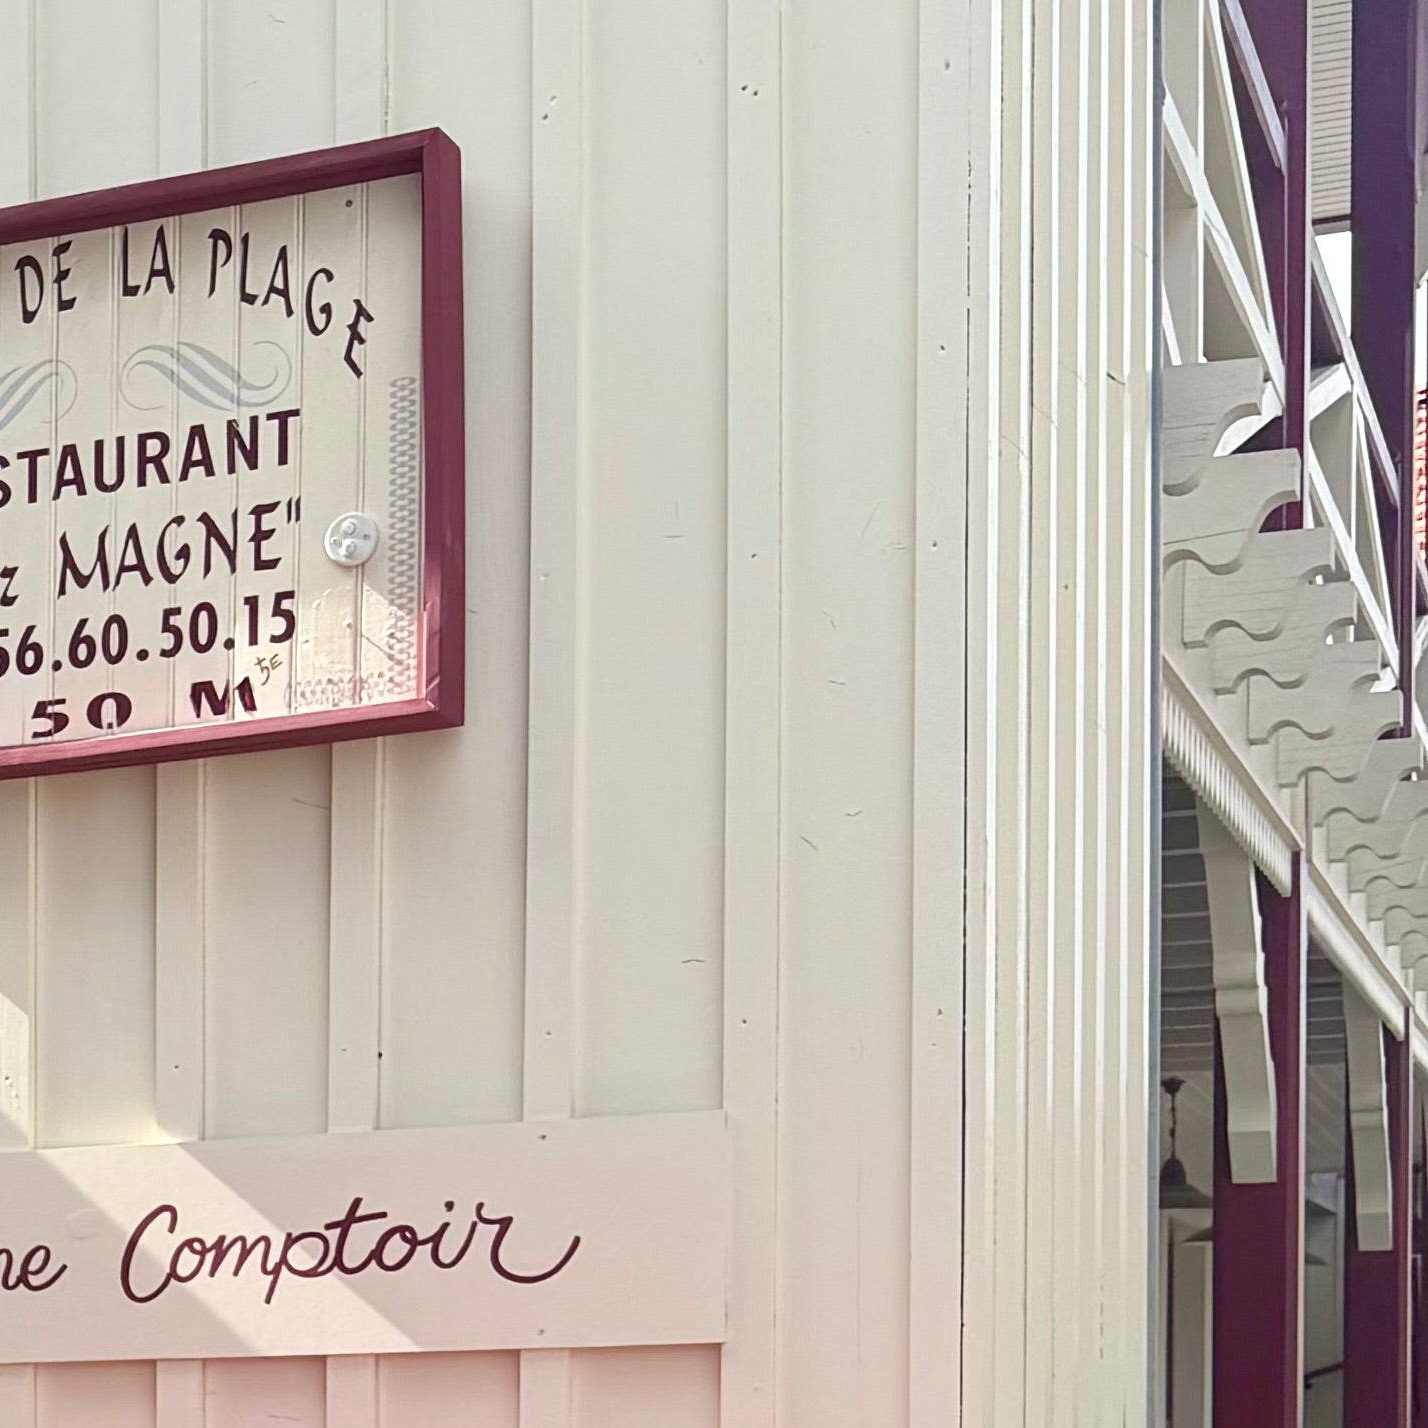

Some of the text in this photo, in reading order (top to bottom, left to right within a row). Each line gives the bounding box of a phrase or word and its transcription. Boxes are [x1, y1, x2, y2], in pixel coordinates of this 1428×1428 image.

[13, 240, 78, 324] DE
[121, 225, 176, 298] LA
[207, 228, 375, 379] PLAGE
[57, 497, 302, 599] MAGNE"
[31, 692, 132, 739] 50
[189, 677, 257, 718] M
[121, 1197, 581, 1304] Comptoir
